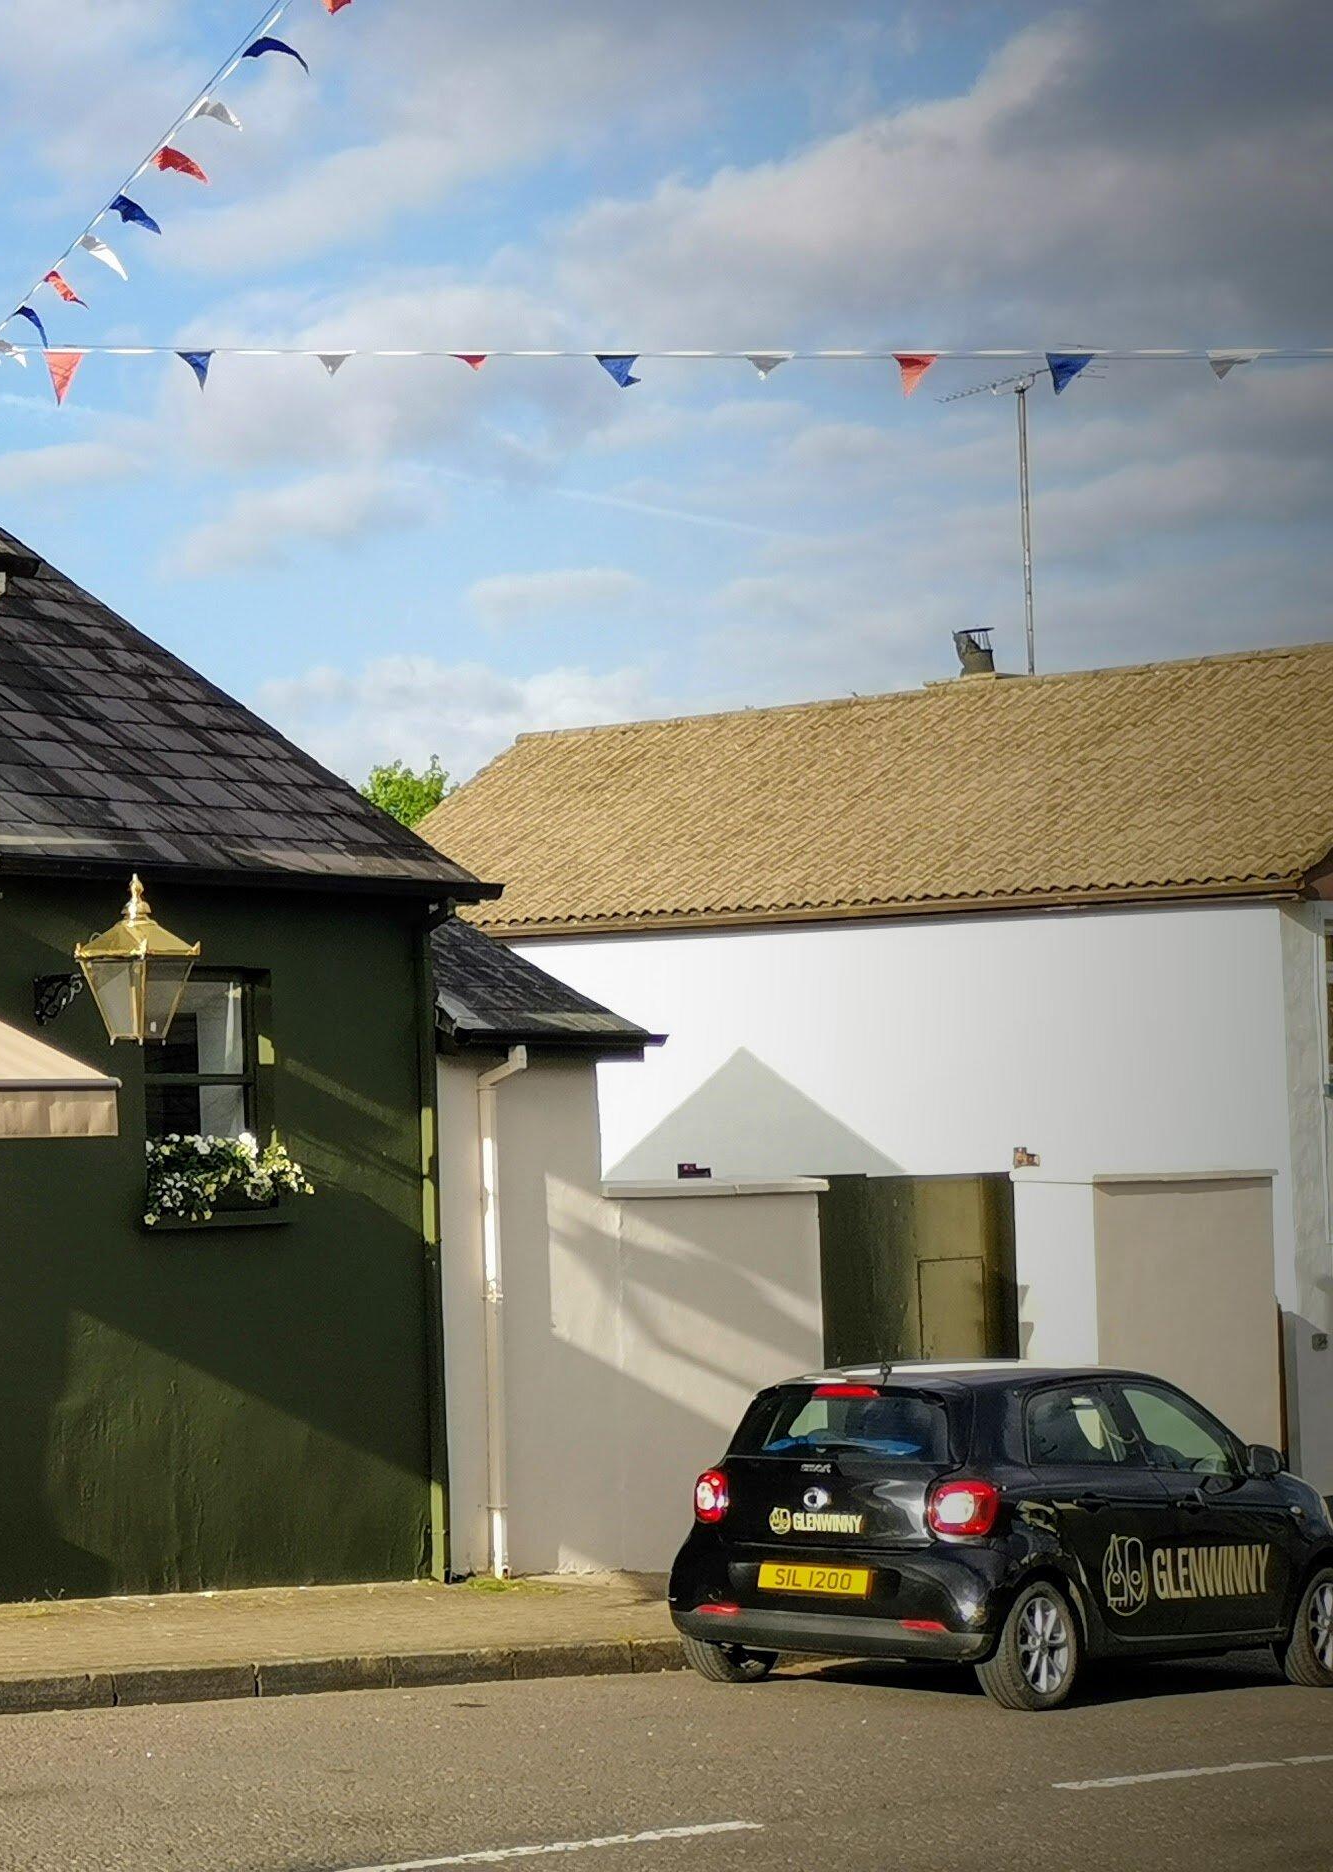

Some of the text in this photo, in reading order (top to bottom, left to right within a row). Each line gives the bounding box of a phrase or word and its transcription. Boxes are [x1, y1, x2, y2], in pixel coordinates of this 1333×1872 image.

[801, 1463, 831, 1474] smart
[793, 1512, 862, 1533] GLENWINNY
[774, 1568, 852, 1590] SIL 1200
[1152, 1543, 1270, 1600] GLENWINNY
